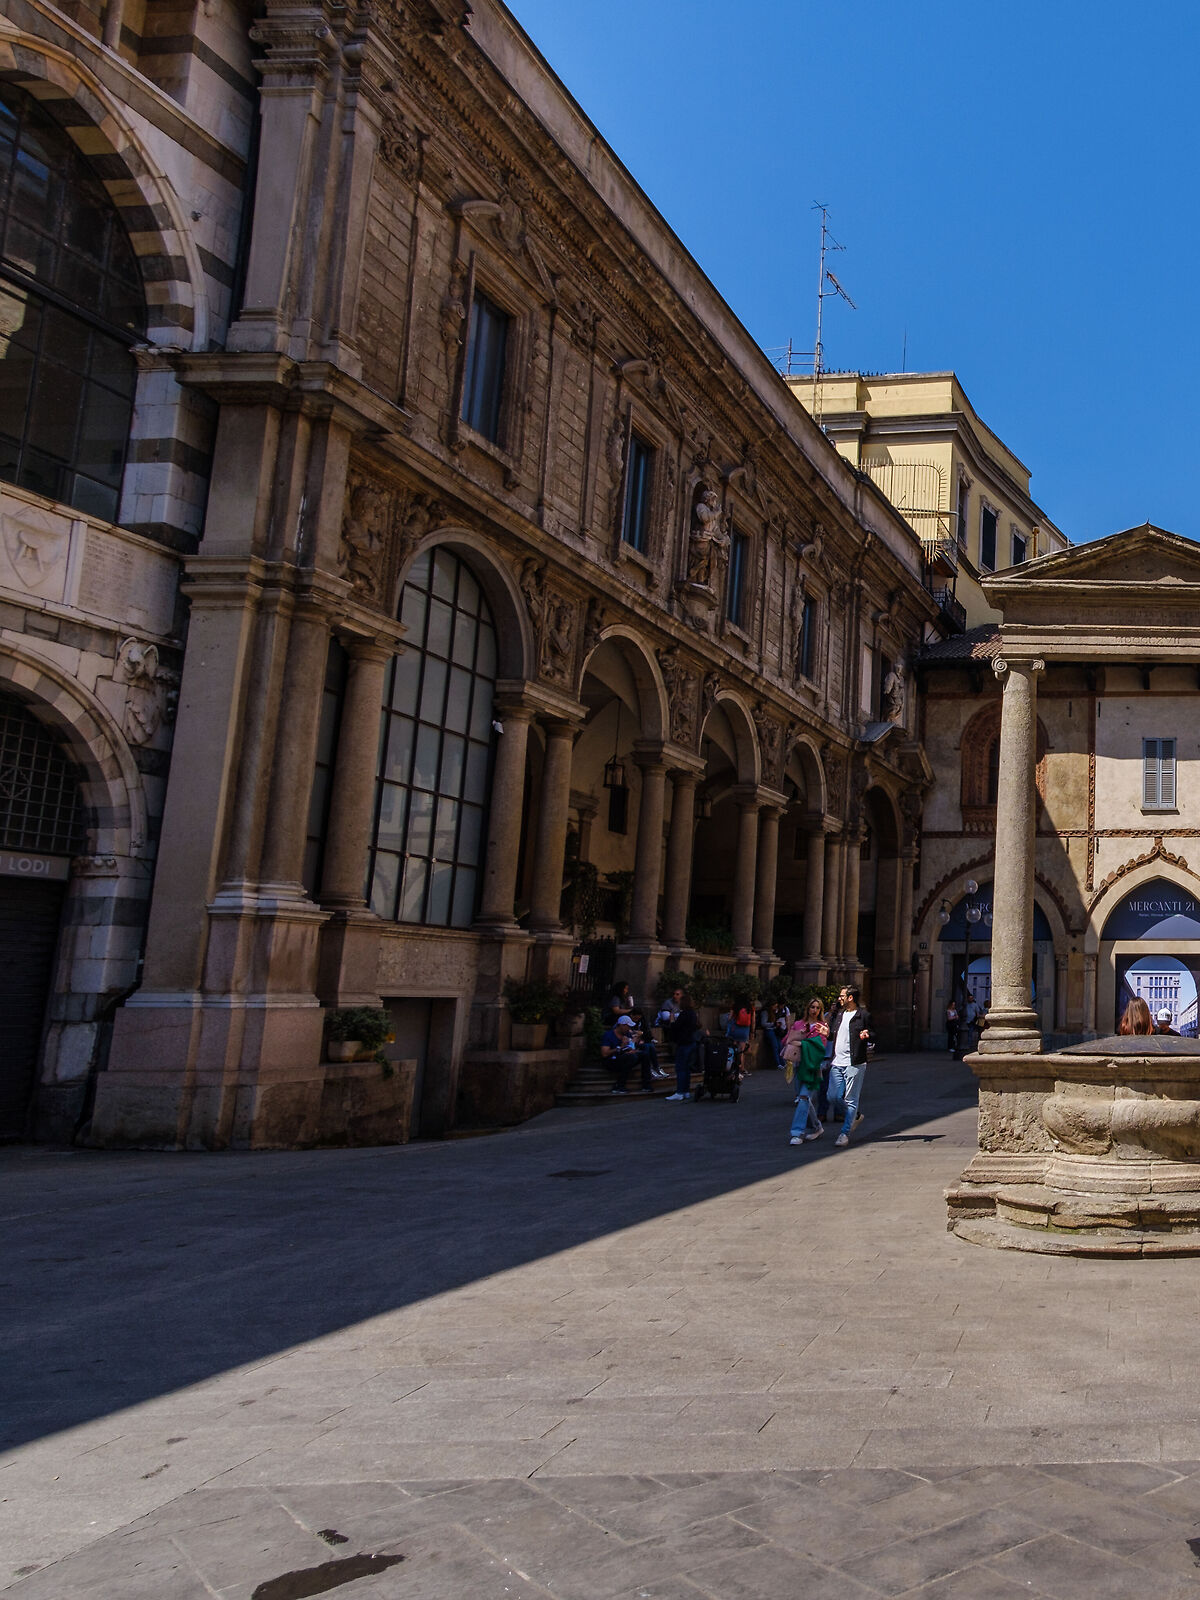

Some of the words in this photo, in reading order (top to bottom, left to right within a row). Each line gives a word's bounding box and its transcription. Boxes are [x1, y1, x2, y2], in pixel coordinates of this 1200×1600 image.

[9, 857, 50, 875] LODI
[1129, 901, 1181, 912] MERCANTI
[1185, 901, 1195, 912] 21
